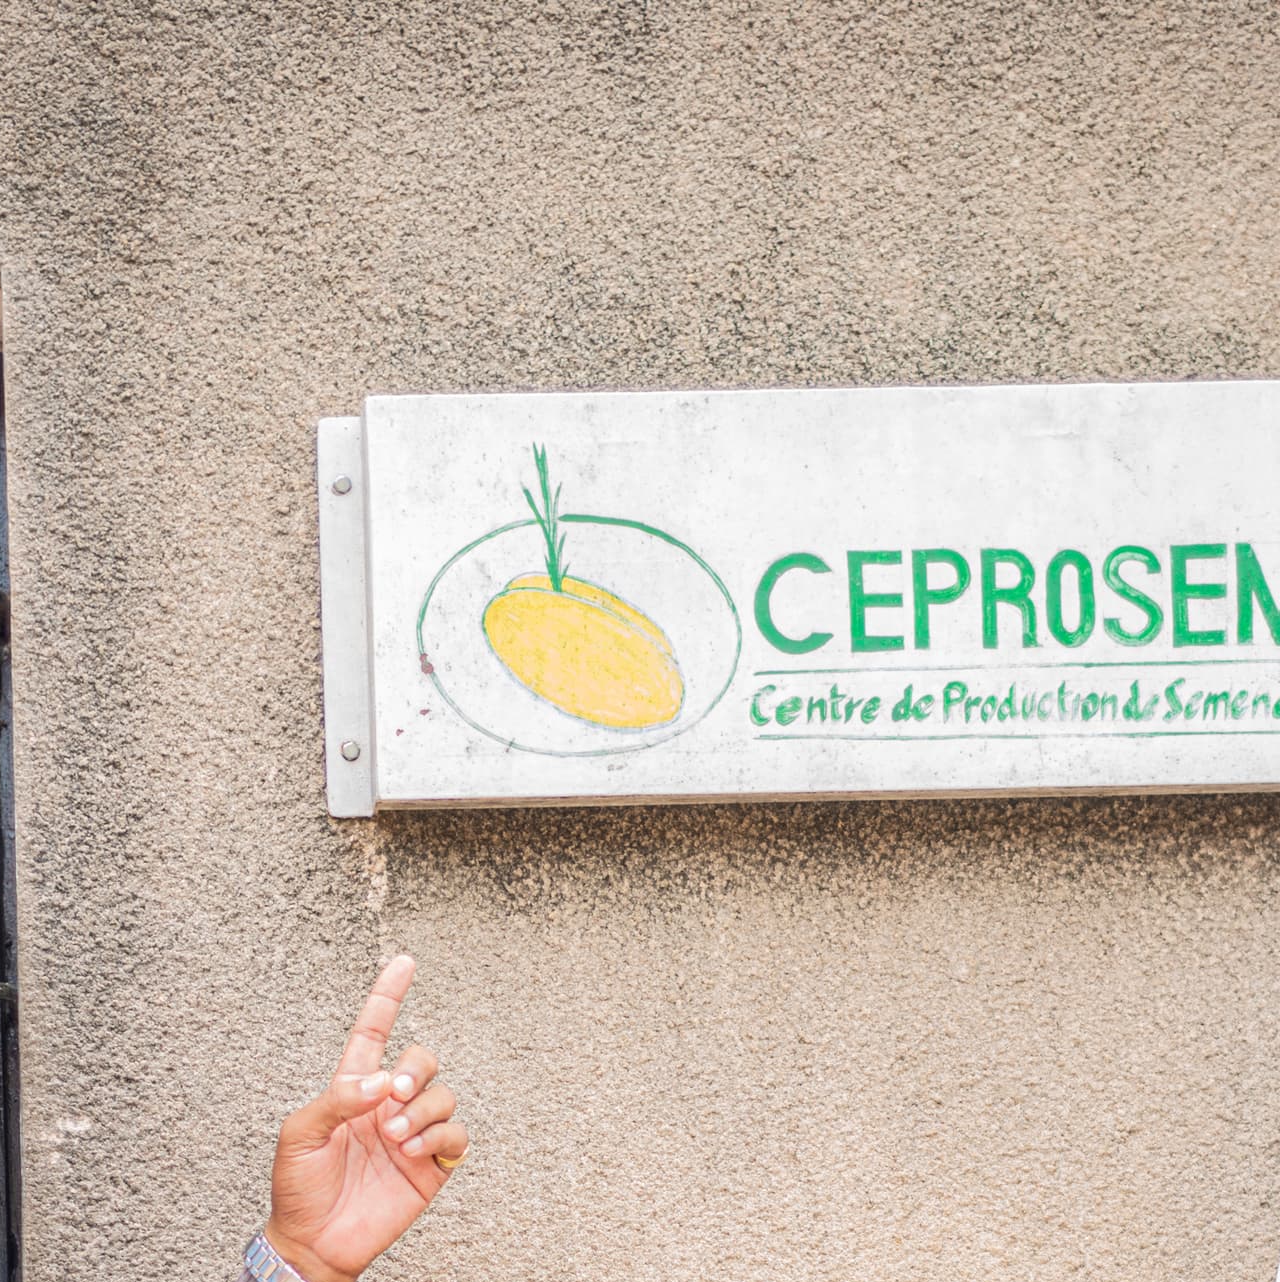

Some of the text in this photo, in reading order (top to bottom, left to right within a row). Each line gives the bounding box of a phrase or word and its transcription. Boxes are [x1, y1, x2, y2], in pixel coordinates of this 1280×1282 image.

[750, 683, 881, 726] Centre
[892, 683, 935, 723] de
[943, 680, 1118, 724] Production
[1122, 679, 1160, 722] de
